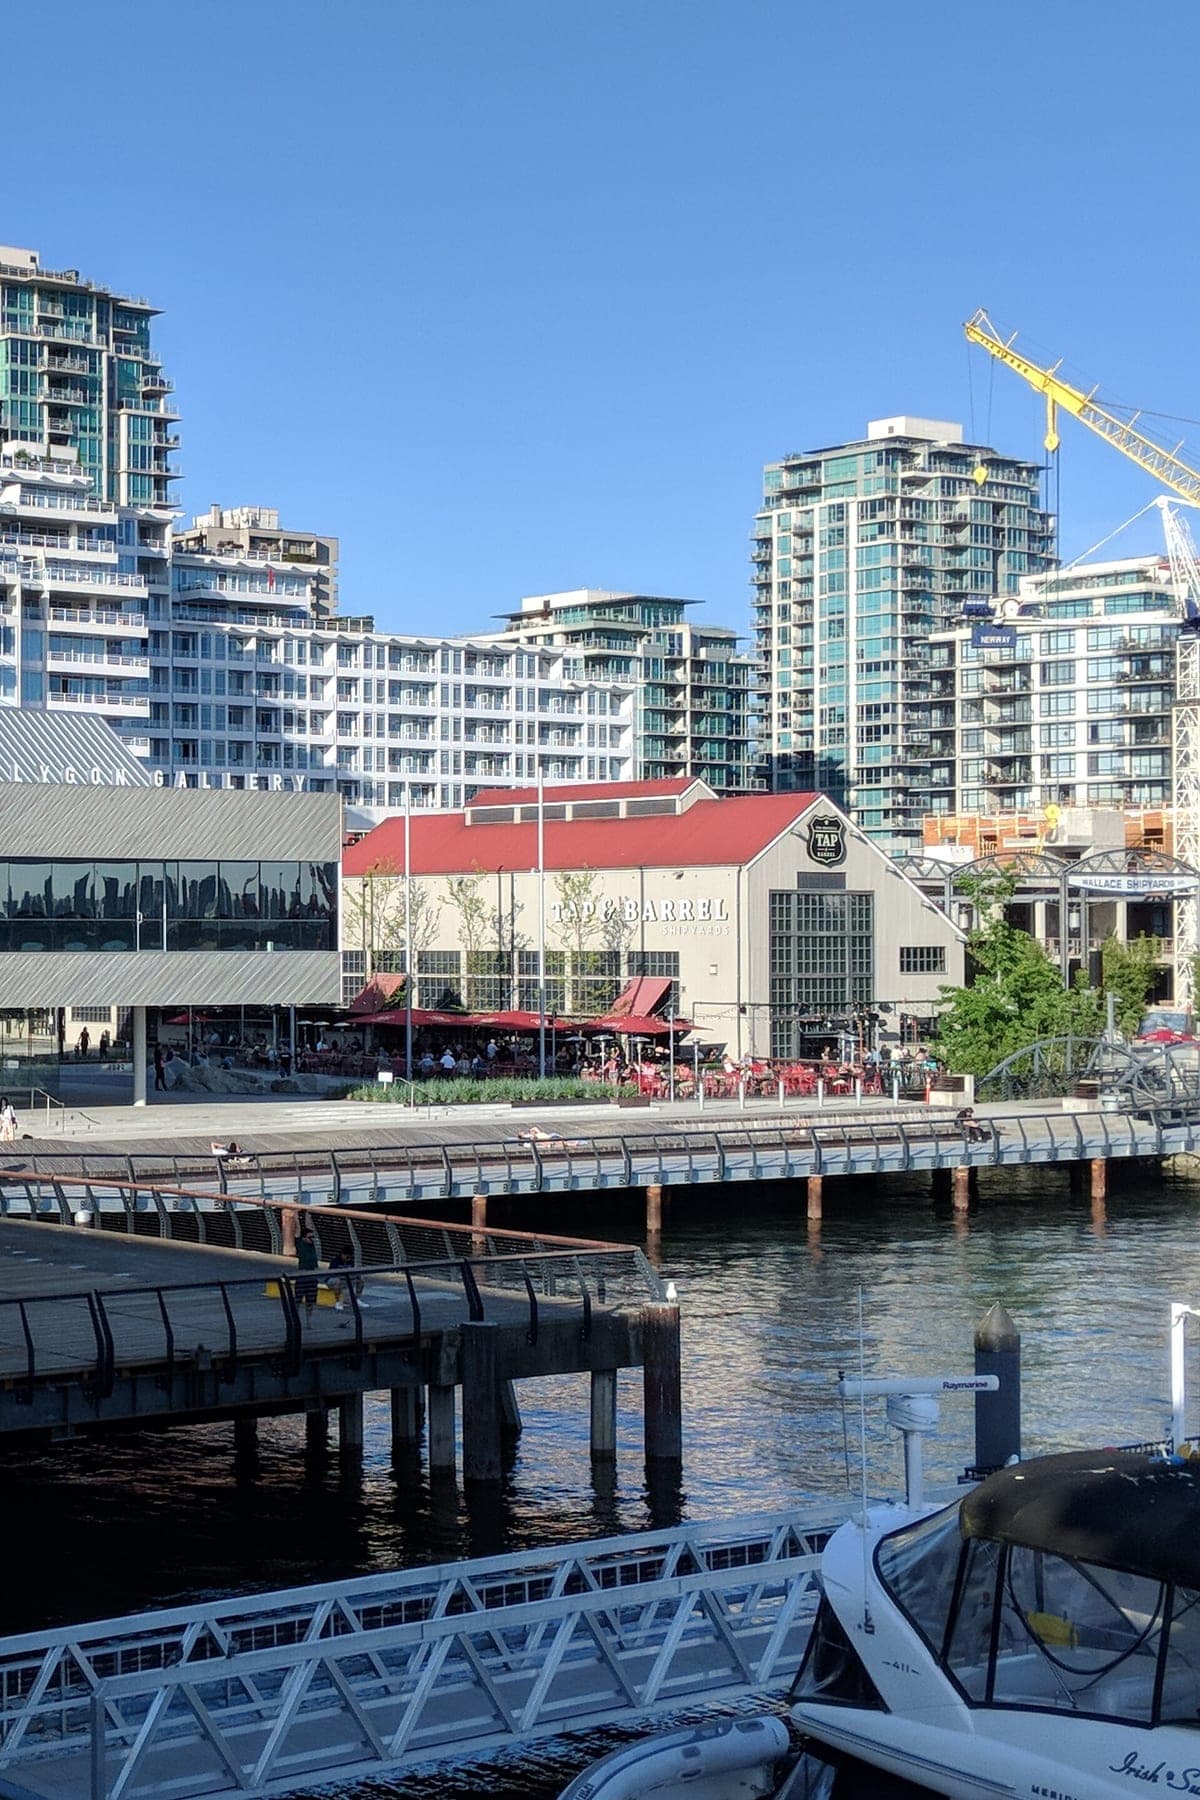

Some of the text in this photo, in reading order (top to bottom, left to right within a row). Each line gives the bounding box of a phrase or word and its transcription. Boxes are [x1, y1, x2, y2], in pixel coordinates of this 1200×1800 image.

[154, 770, 305, 792] GALLERY
[815, 834, 838, 847] TAP
[552, 899, 729, 923] TAP & BARREL
[663, 925, 730, 936] SHIPYARDS
[942, 1381, 988, 1390] Raymarine
[1109, 1752, 1166, 1783] Irish
[1031, 1784, 1078, 1800] MERID
